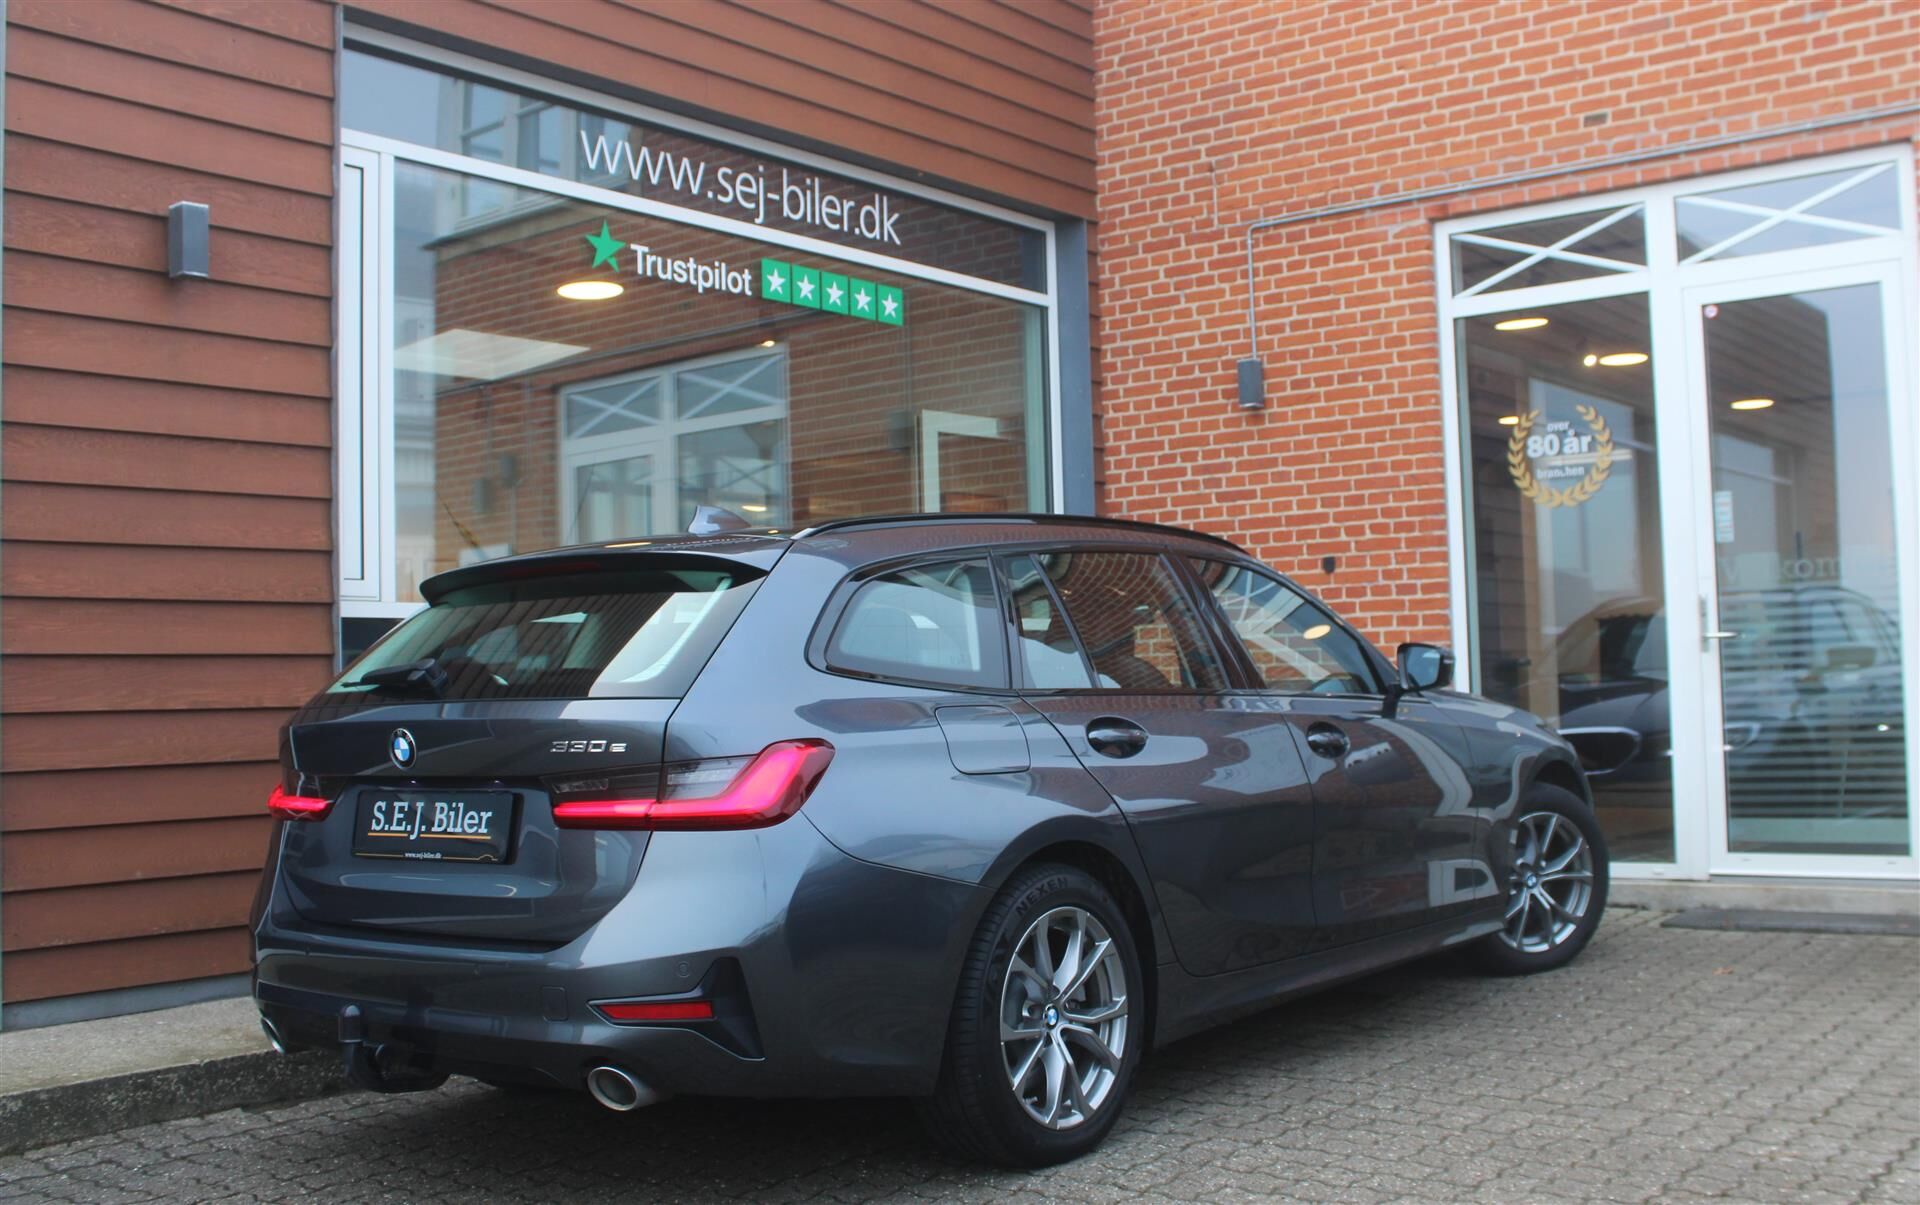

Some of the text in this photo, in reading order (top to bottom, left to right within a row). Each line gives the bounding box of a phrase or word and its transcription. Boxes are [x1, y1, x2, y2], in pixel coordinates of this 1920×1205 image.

[580, 130, 901, 246] www.sej-biler.dk
[630, 243, 753, 296] Trustpilot
[1526, 428, 1592, 459] 80 år
[371, 801, 492, 840] S.E.J. Biler
[1015, 876, 1069, 917] NEXEN
